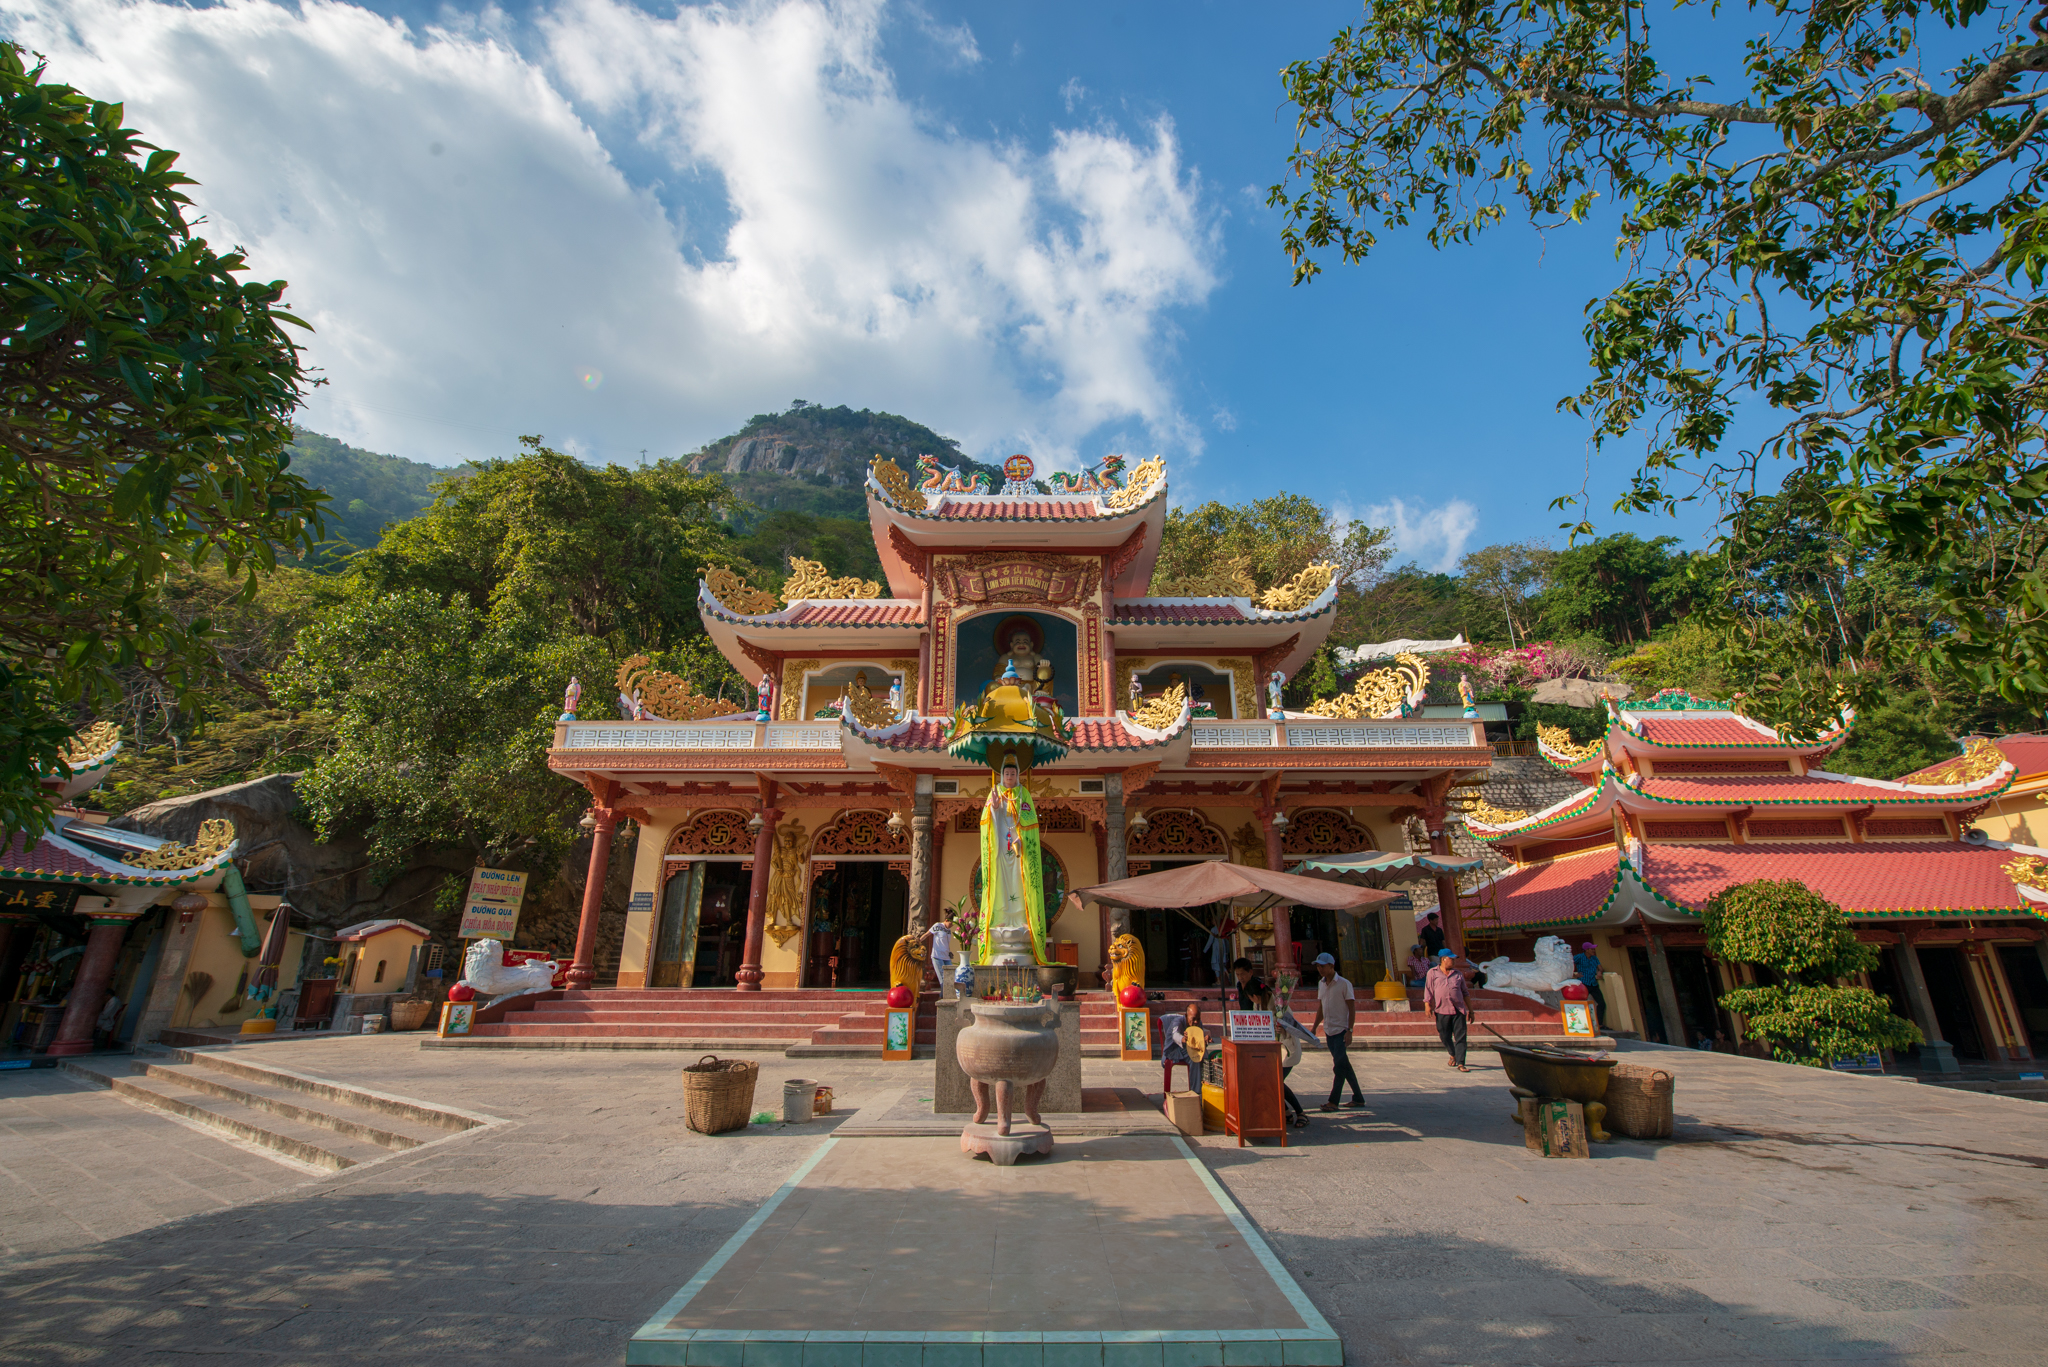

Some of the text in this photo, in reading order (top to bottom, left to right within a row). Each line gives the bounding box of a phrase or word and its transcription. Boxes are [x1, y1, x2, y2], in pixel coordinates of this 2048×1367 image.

[986, 579, 999, 590] LINH
[481, 871, 520, 882] ĐƯỜNG LÊN
[472, 905, 496, 914] ĐƯỜNG
